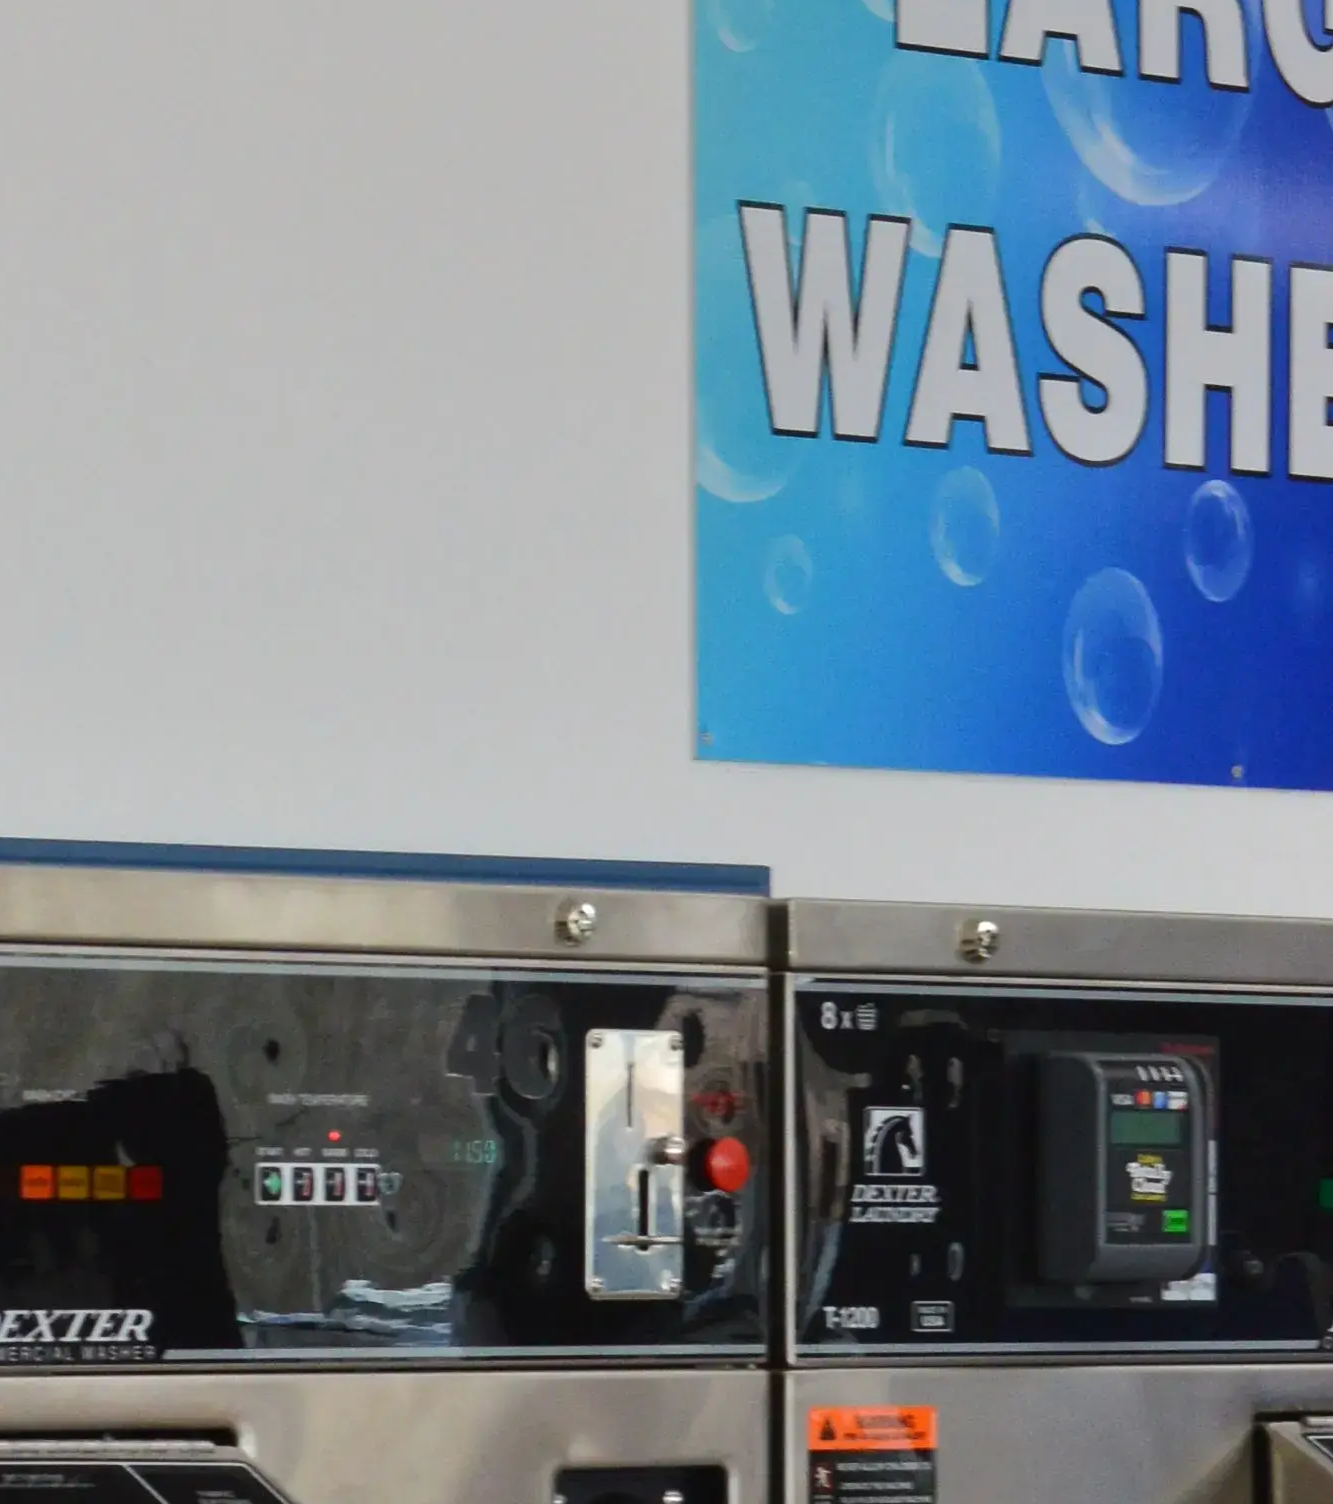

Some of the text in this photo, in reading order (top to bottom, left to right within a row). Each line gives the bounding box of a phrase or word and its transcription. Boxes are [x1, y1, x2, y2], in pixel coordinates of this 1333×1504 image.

[820, 1001, 838, 1030] 8
[850, 1184, 940, 1203] DEXTER
[80, 1344, 158, 1362] WASHER
